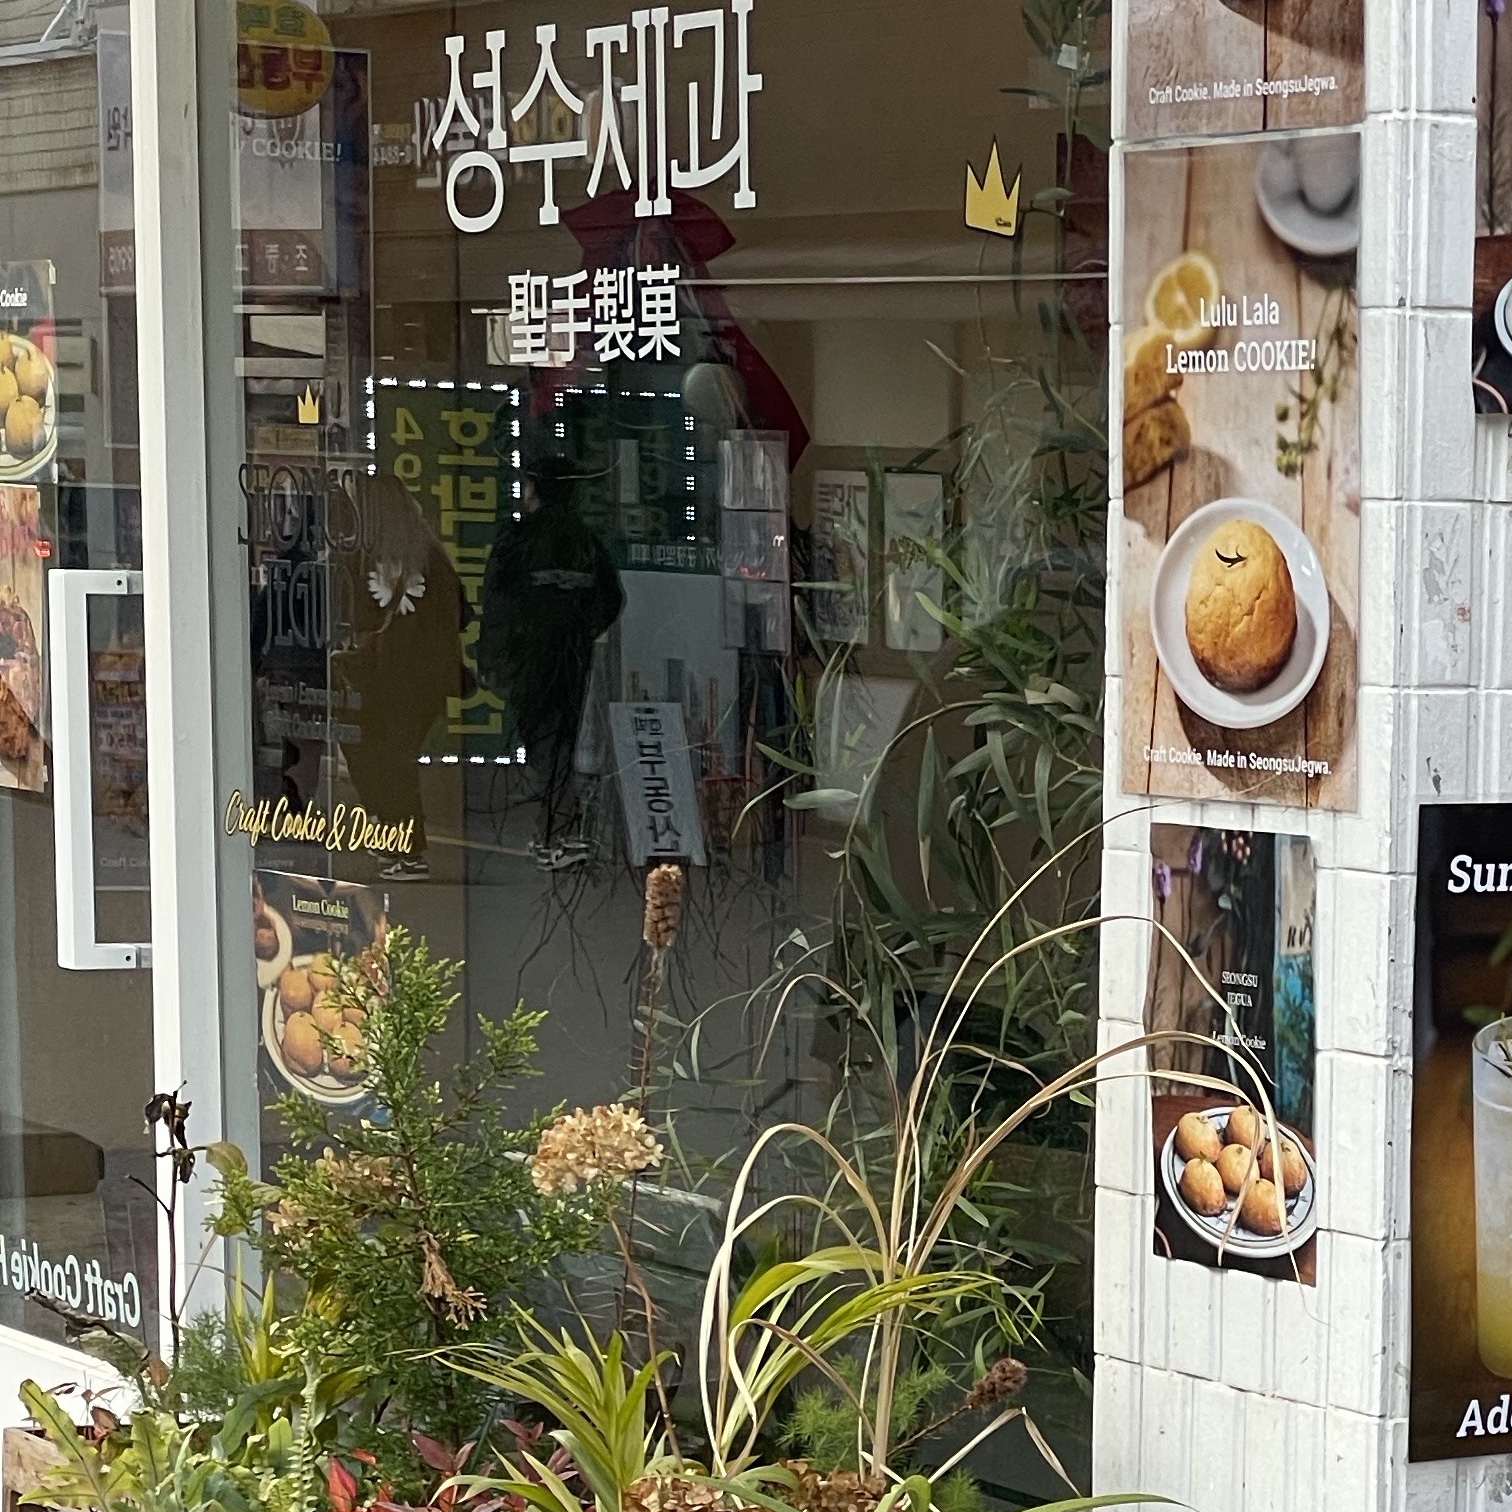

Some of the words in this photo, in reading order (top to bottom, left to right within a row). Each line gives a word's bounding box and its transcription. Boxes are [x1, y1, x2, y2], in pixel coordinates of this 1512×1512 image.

[1149, 85, 1173, 104] Craft
[1213, 79, 1240, 99] Made
[1243, 78, 1253, 96] in
[432, 0, 764, 233] 성수제과
[507, 263, 682, 364] 聖手製菓
[1200, 295, 1237, 328] Lulu
[1242, 293, 1280, 326] Lala
[1165, 344, 1230, 374] Lemon
[1233, 339, 1317, 372] COOKIE!
[1143, 745, 1167, 763] Craft
[1206, 749, 1235, 768] Made
[1237, 751, 1247, 769] in
[225, 790, 269, 847] Craft
[271, 796, 325, 842] Cookie
[325, 803, 345, 851] &
[348, 805, 414, 853] Dessert
[293, 894, 318, 914] Lemon
[321, 897, 349, 917] Cookie
[1222, 971, 1258, 988] SEONGSU
[1227, 992, 1253, 1007] JEGUA
